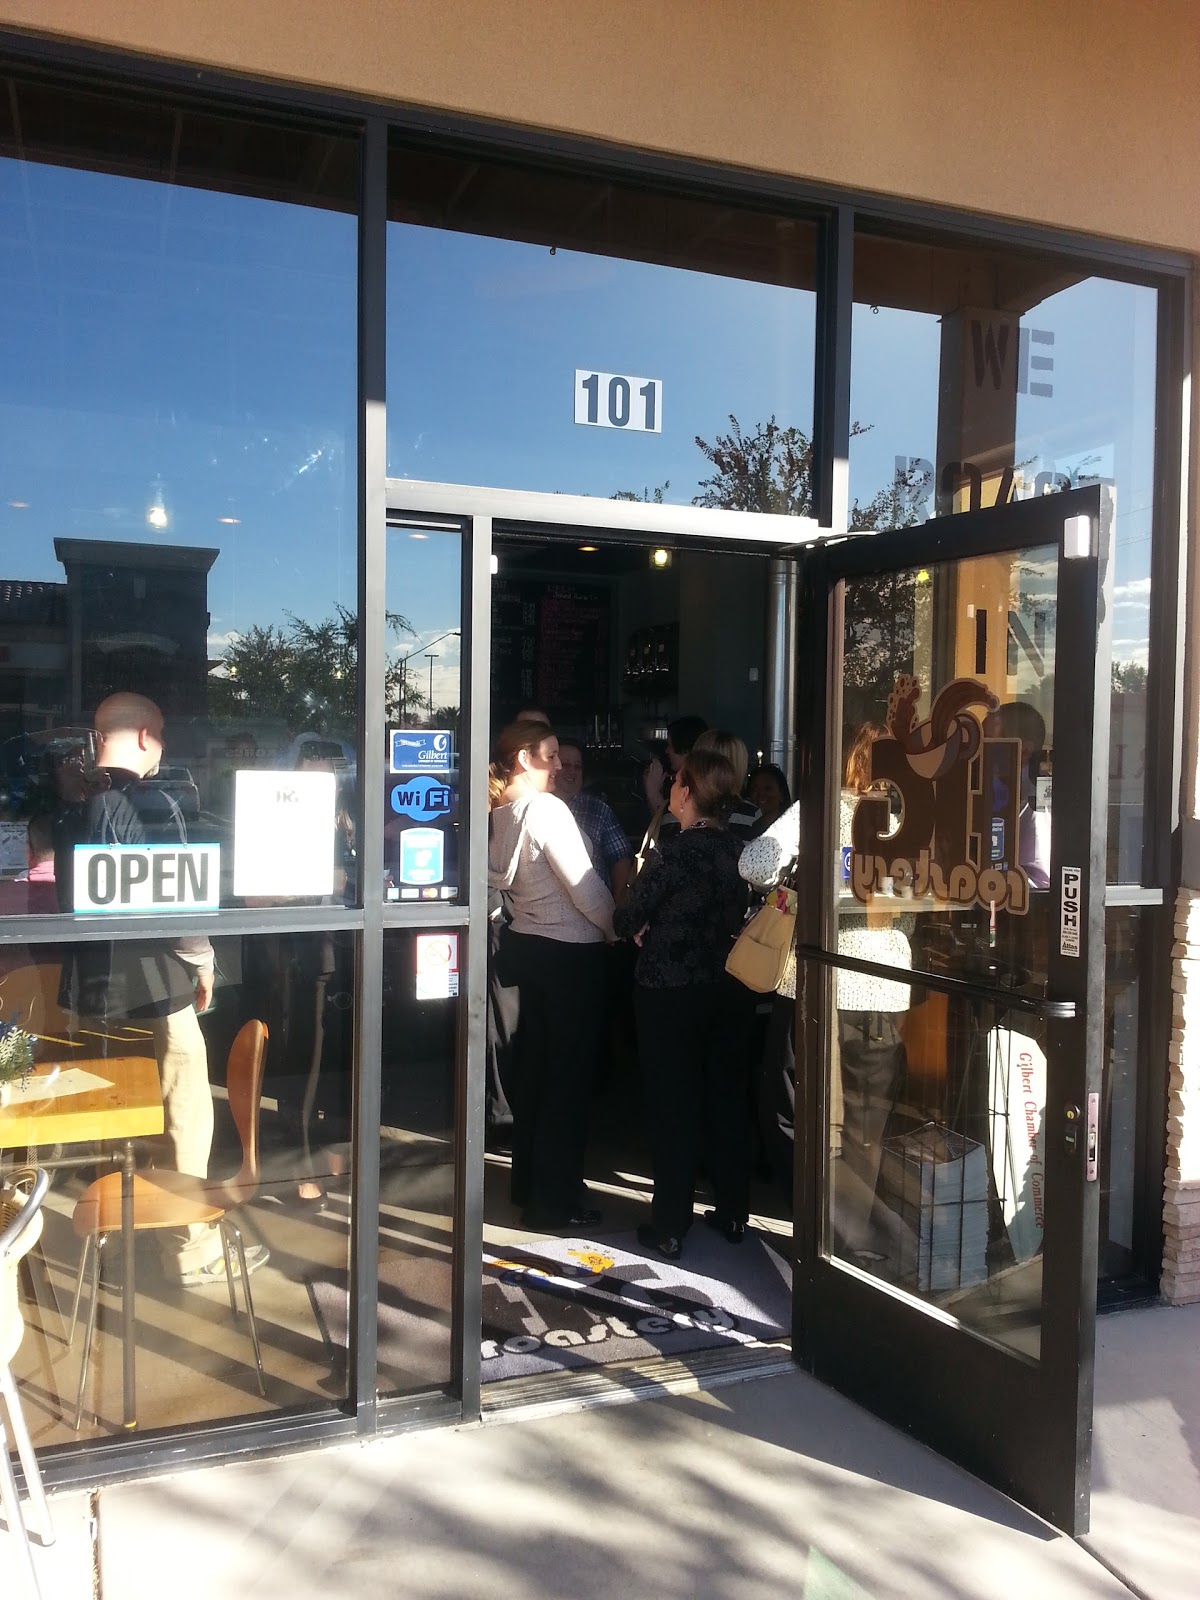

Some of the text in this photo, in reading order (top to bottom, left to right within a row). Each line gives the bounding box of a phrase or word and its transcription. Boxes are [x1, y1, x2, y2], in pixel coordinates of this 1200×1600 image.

[970, 319, 1055, 398] WE
[582, 373, 656, 430] 101
[975, 608, 1046, 678] IN
[418, 750, 448, 760] Gilbert
[88, 852, 208, 905] OPEN
[1063, 873, 1079, 927] PUSH
[1062, 941, 1078, 950] Atlas
[1019, 1052, 1044, 1229] Gilbert Chamber of Commerce
[481, 1307, 736, 1359] roastery
